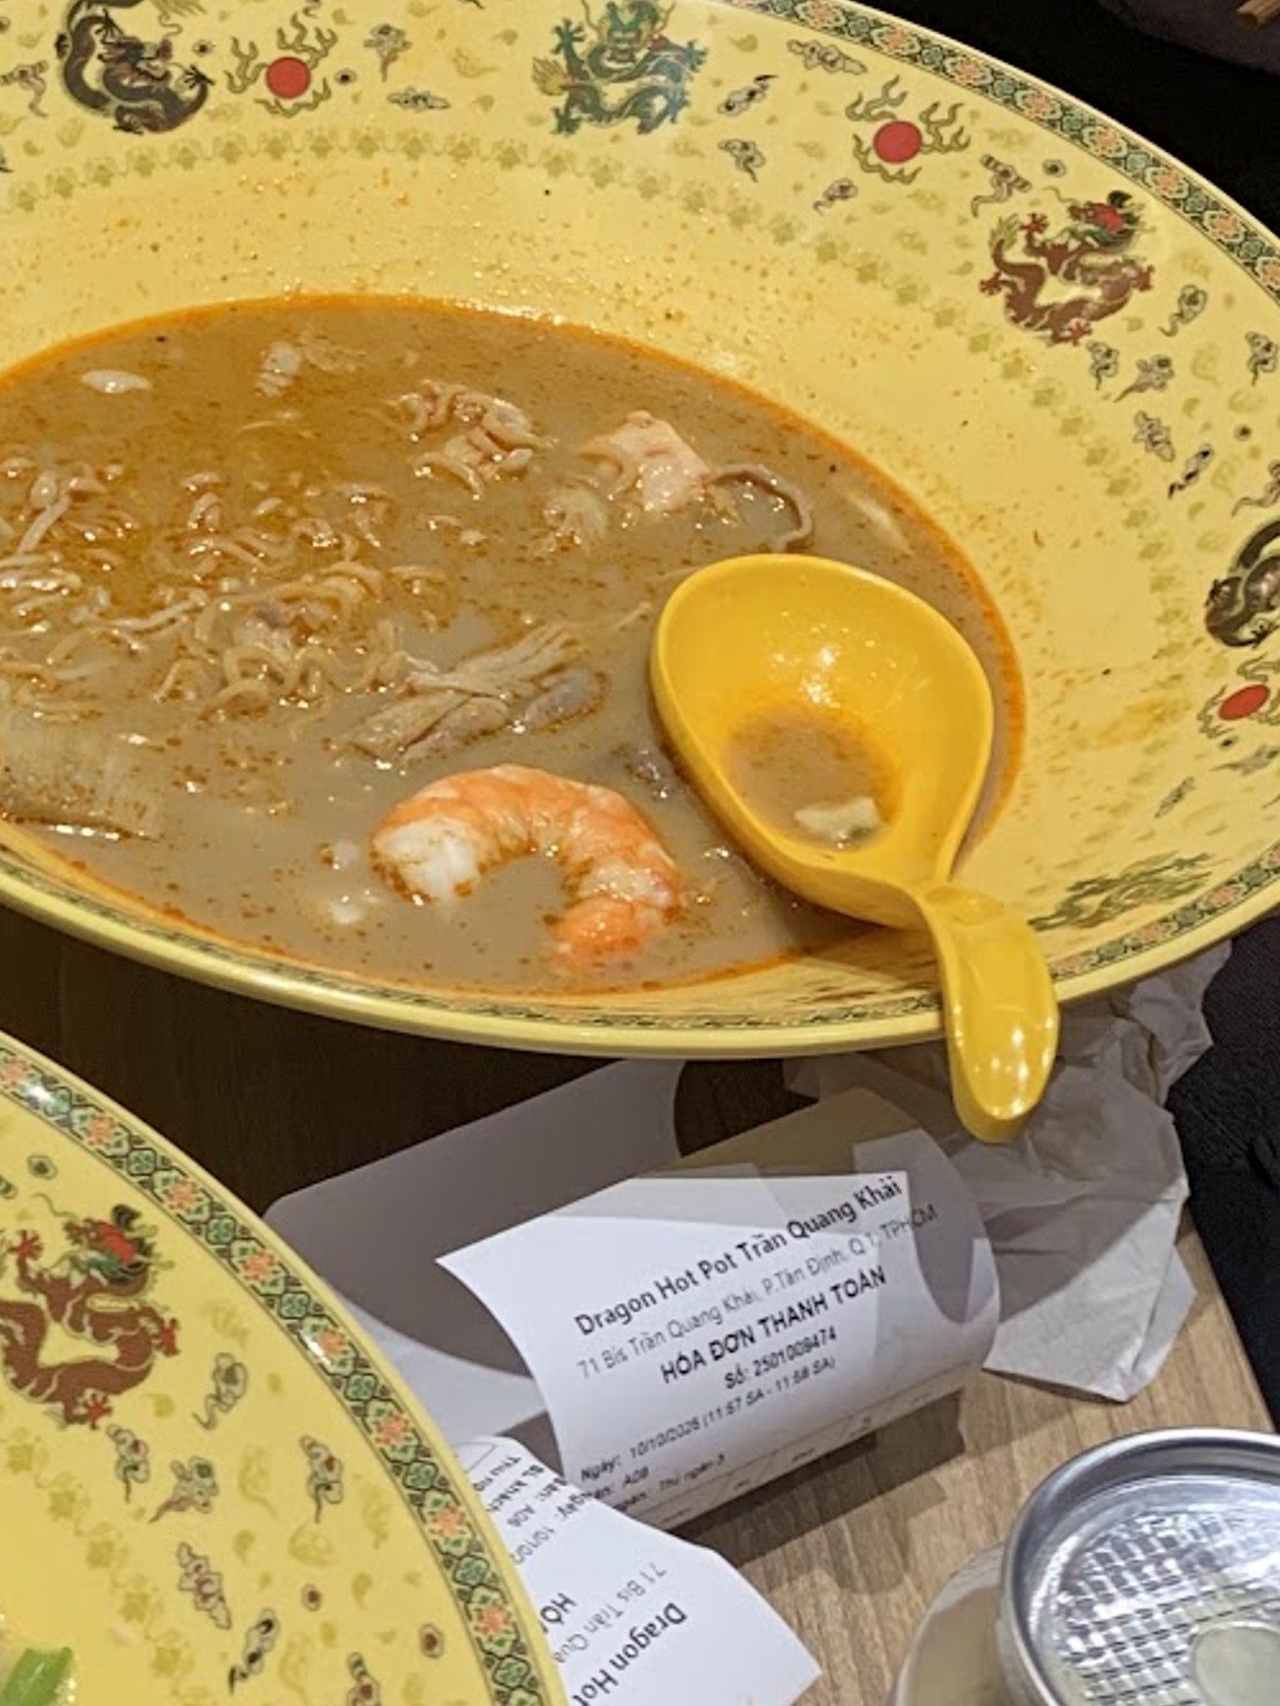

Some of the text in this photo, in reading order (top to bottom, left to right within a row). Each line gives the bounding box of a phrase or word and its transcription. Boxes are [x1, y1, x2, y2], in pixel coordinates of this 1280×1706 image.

[574, 1175, 903, 1336] Dragon Hot Pot Trần Quang Khải
[577, 1357, 600, 1379] 71
[667, 1306, 724, 1339] Quang
[879, 1204, 939, 1240] TPHCM
[660, 1265, 887, 1385] HÓA ĐƠN THANH TOÁN
[616, 1579, 646, 1603] Bis
[640, 1561, 667, 1583] 71
[539, 1592, 578, 1634] HÓ
[609, 1601, 688, 1671] Dragon
[553, 1633, 590, 1664] Qua
